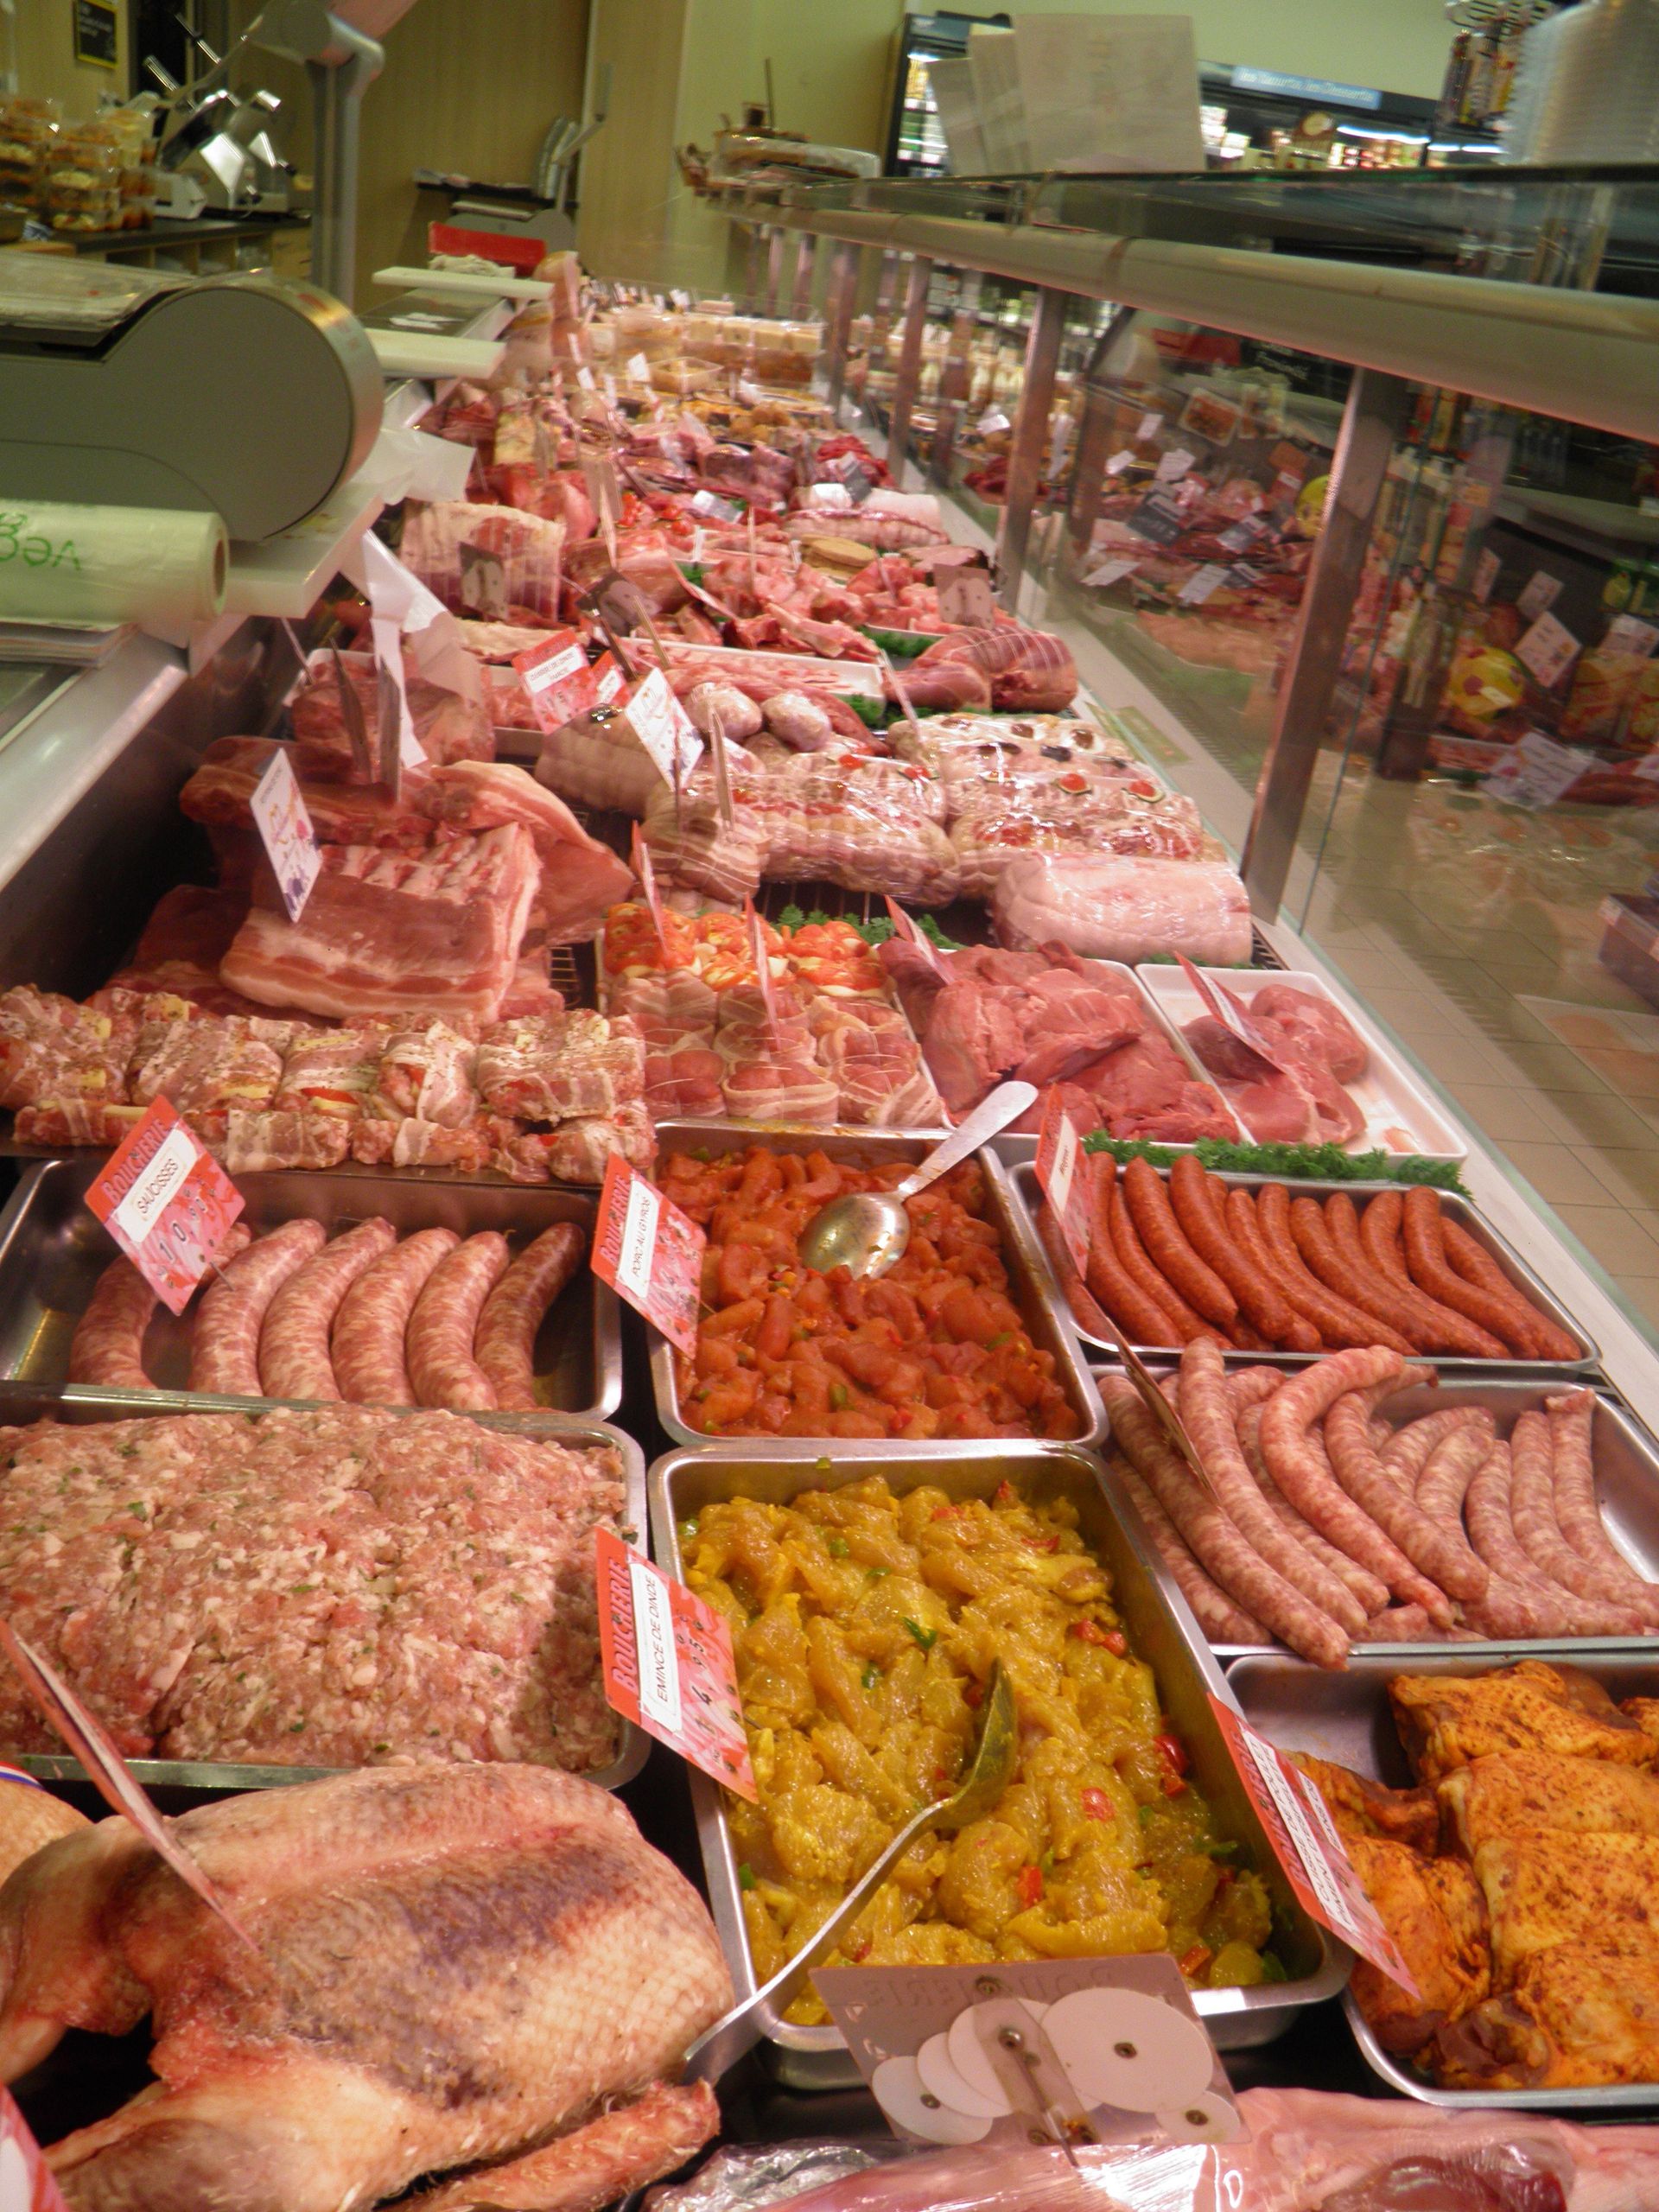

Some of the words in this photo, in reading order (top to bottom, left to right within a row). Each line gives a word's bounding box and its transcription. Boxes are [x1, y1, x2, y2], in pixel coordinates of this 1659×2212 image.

[137, 1158, 179, 1214] SAUCISSES
[645, 1575, 658, 1618] DINDE
[608, 1557, 639, 1696] BOUCHERIE
[651, 1619, 661, 1642] DE
[652, 1643, 668, 1703] EMINCE
